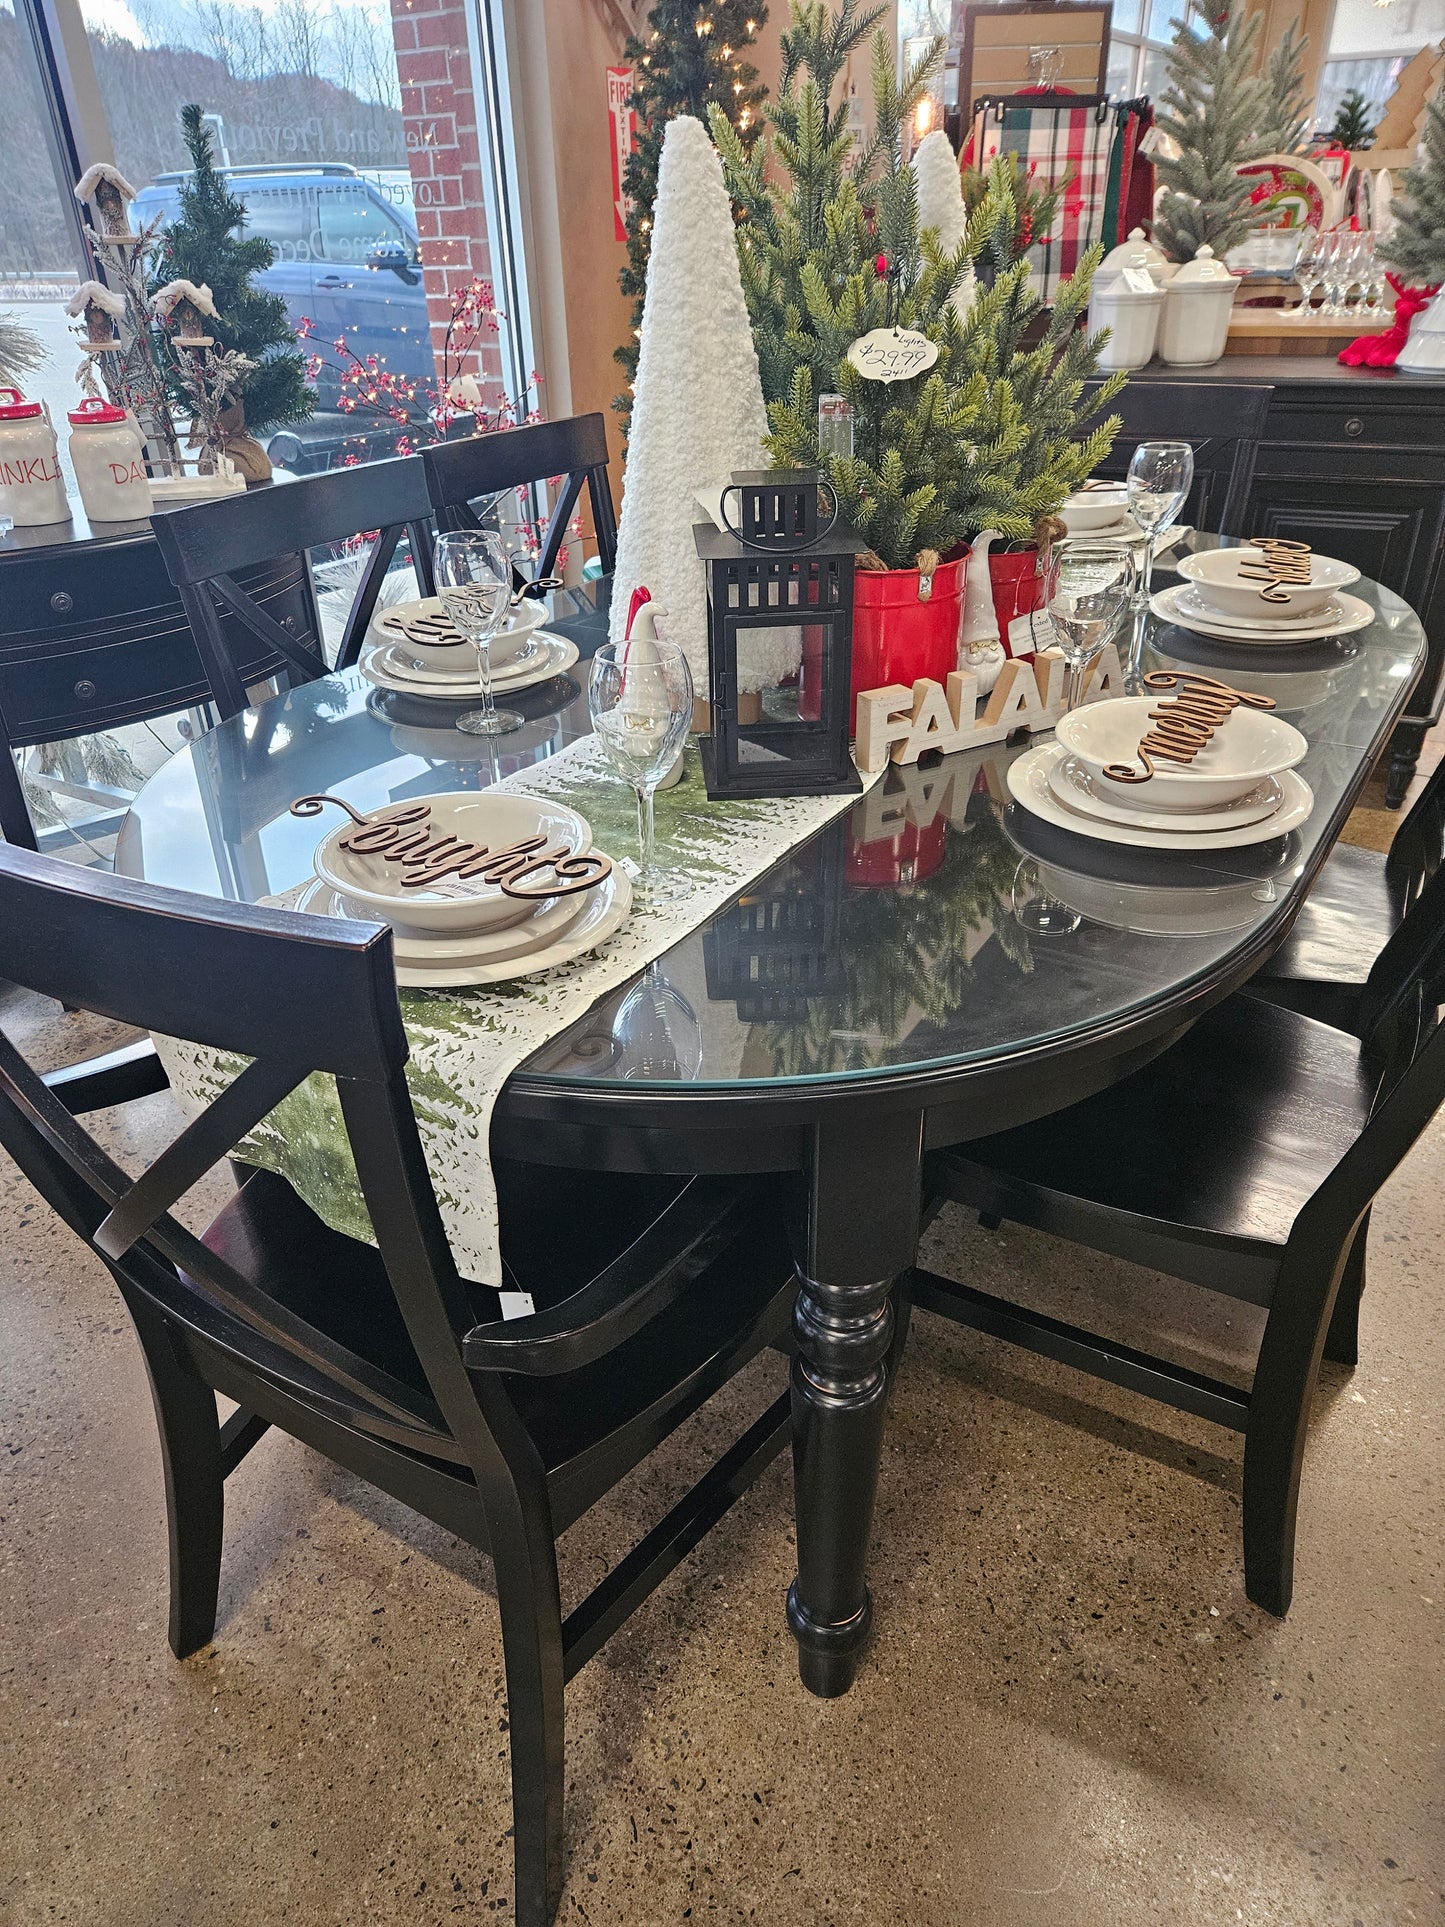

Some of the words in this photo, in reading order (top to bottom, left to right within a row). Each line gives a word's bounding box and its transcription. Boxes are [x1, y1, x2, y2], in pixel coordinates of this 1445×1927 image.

[609, 80, 632, 103] FIRE
[859, 342, 927, 368] $29.99
[1102, 670, 1277, 784] merry
[289, 794, 613, 899] bright
